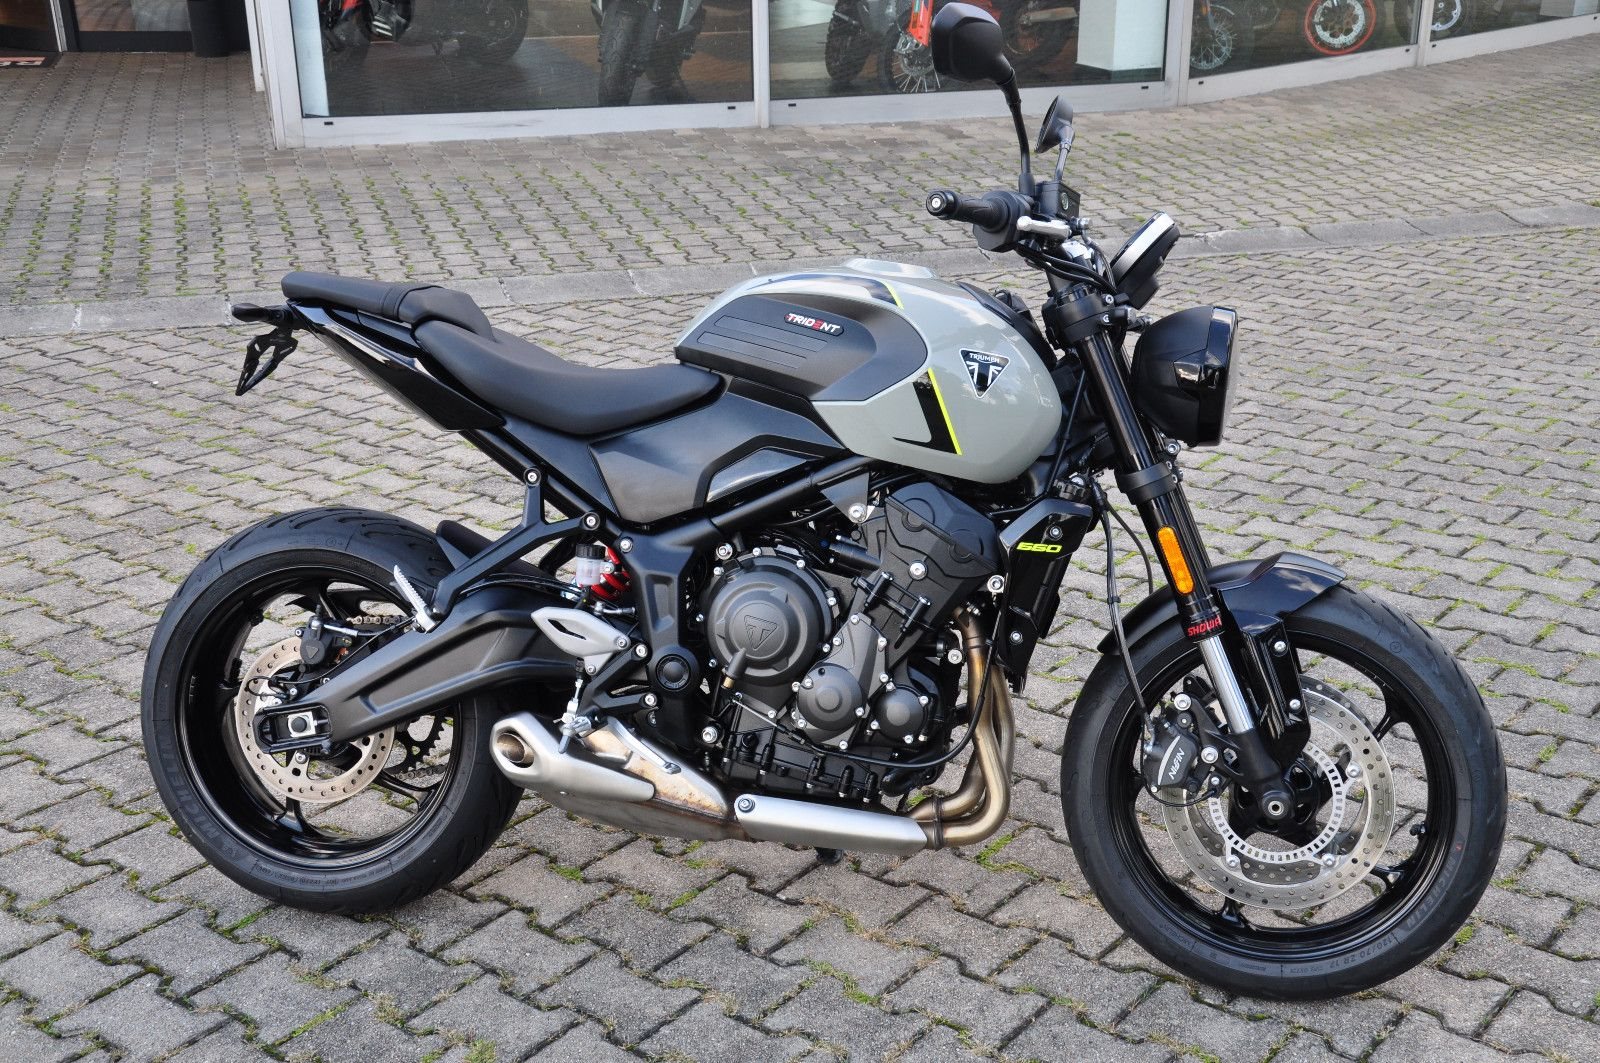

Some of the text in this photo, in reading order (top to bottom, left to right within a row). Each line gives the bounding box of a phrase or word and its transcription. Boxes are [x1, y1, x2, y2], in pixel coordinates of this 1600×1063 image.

[787, 312, 841, 333] TRIDENT
[969, 352, 1000, 364] TRIUMPH
[1016, 541, 1063, 553] 660
[1187, 614, 1223, 637] SHOWA
[158, 733, 221, 841] MICHELIN
[1406, 856, 1456, 929] MICHELIN
